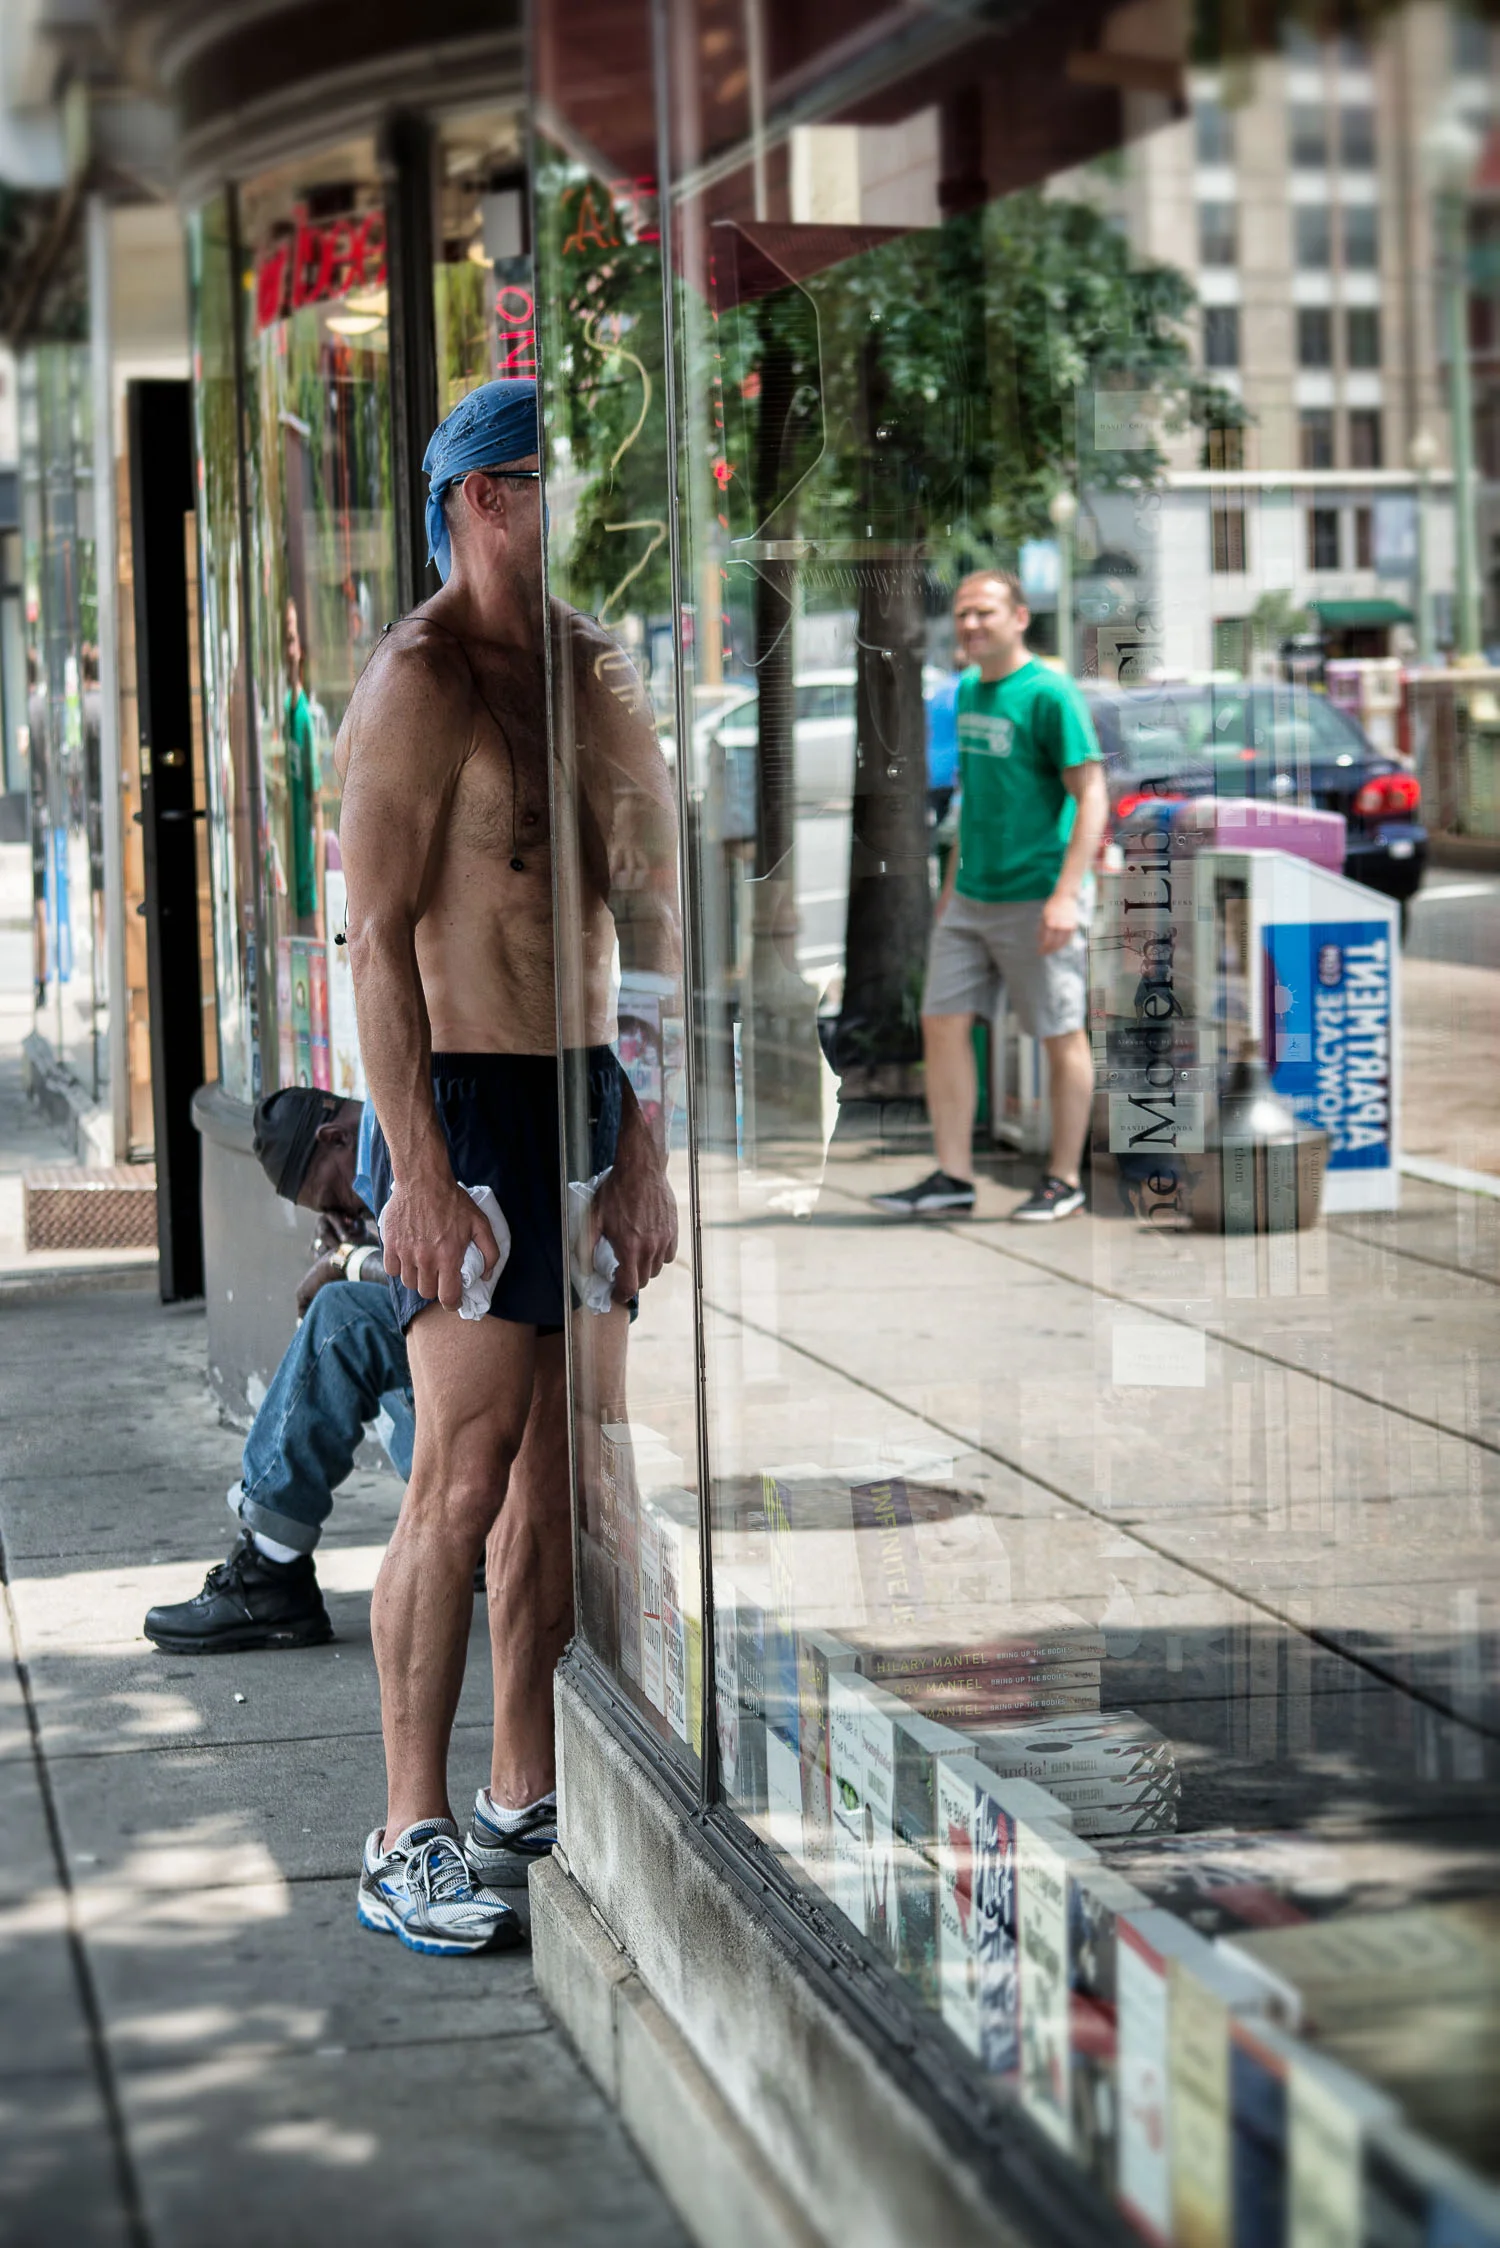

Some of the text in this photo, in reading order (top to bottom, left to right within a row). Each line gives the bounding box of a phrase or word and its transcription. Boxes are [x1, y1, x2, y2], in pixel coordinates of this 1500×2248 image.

[1122, 718, 1173, 914] Libay
[1123, 933, 1177, 1148] Modern
[868, 1484, 910, 1596] INFINITE
[876, 1657, 926, 1674] HILARY
[932, 1653, 989, 1669] MANTEL
[996, 1651, 1019, 1660] BRING
[1021, 1650, 1031, 1658] UP
[1033, 1649, 1046, 1657] THE
[925, 1678, 984, 1694] MANTEL
[1015, 1677, 1026, 1685] UP
[1027, 1675, 1041, 1684] THE
[925, 1704, 983, 1720] MANTEL
[1014, 1702, 1025, 1710] UP
[1027, 1701, 1040, 1709] THE
